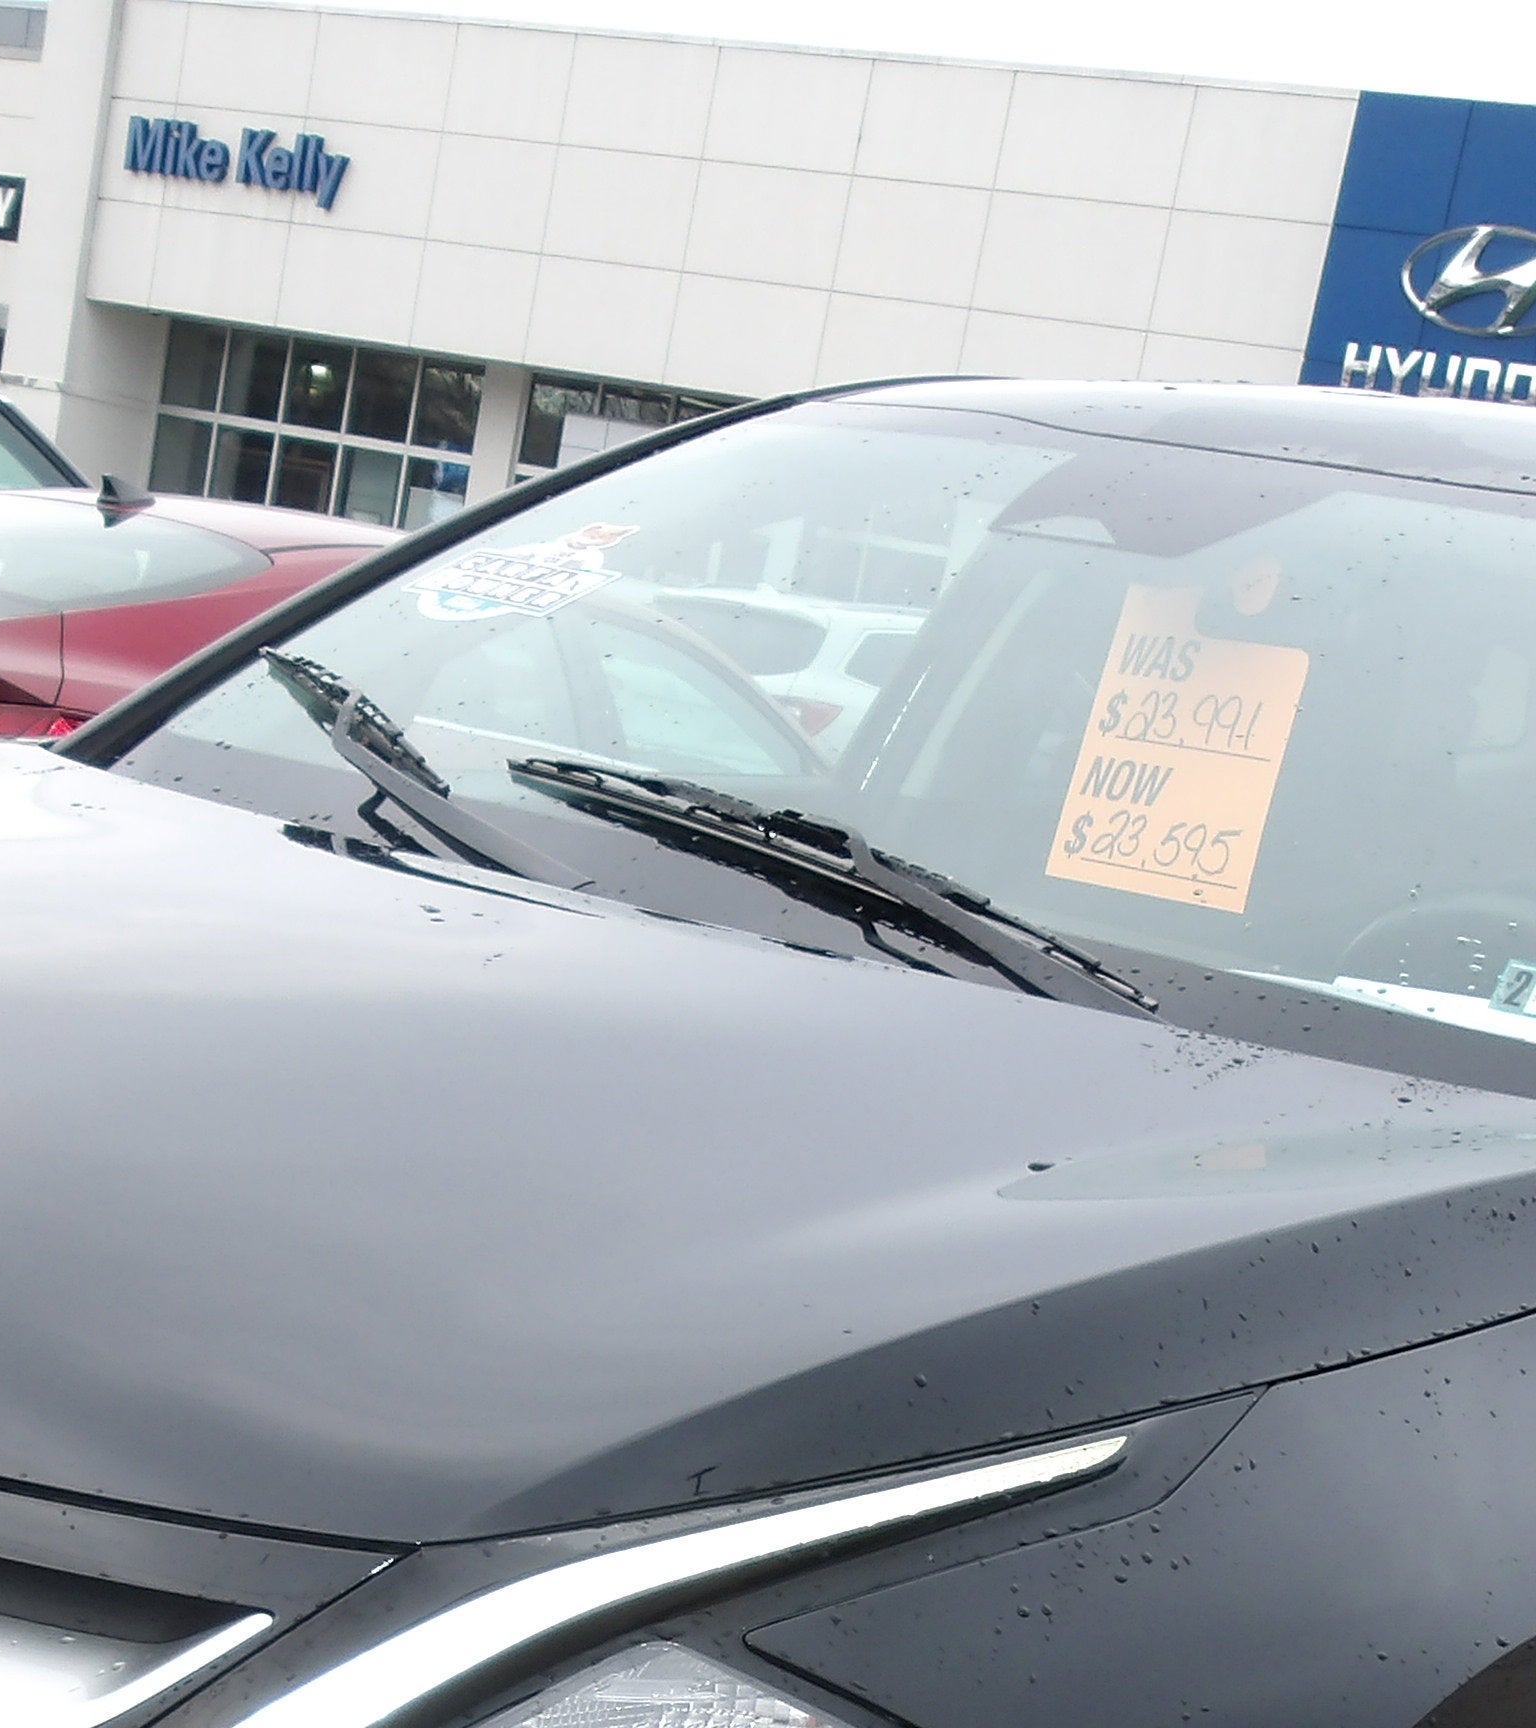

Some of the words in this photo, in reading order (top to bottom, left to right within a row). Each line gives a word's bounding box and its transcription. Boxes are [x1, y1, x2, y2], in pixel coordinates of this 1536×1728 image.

[124, 115, 231, 183] Mike
[235, 126, 351, 211] Kelly
[1118, 633, 1200, 683] WAS
[1079, 755, 1174, 807] NOW
[1503, 971, 1533, 1006] 2
